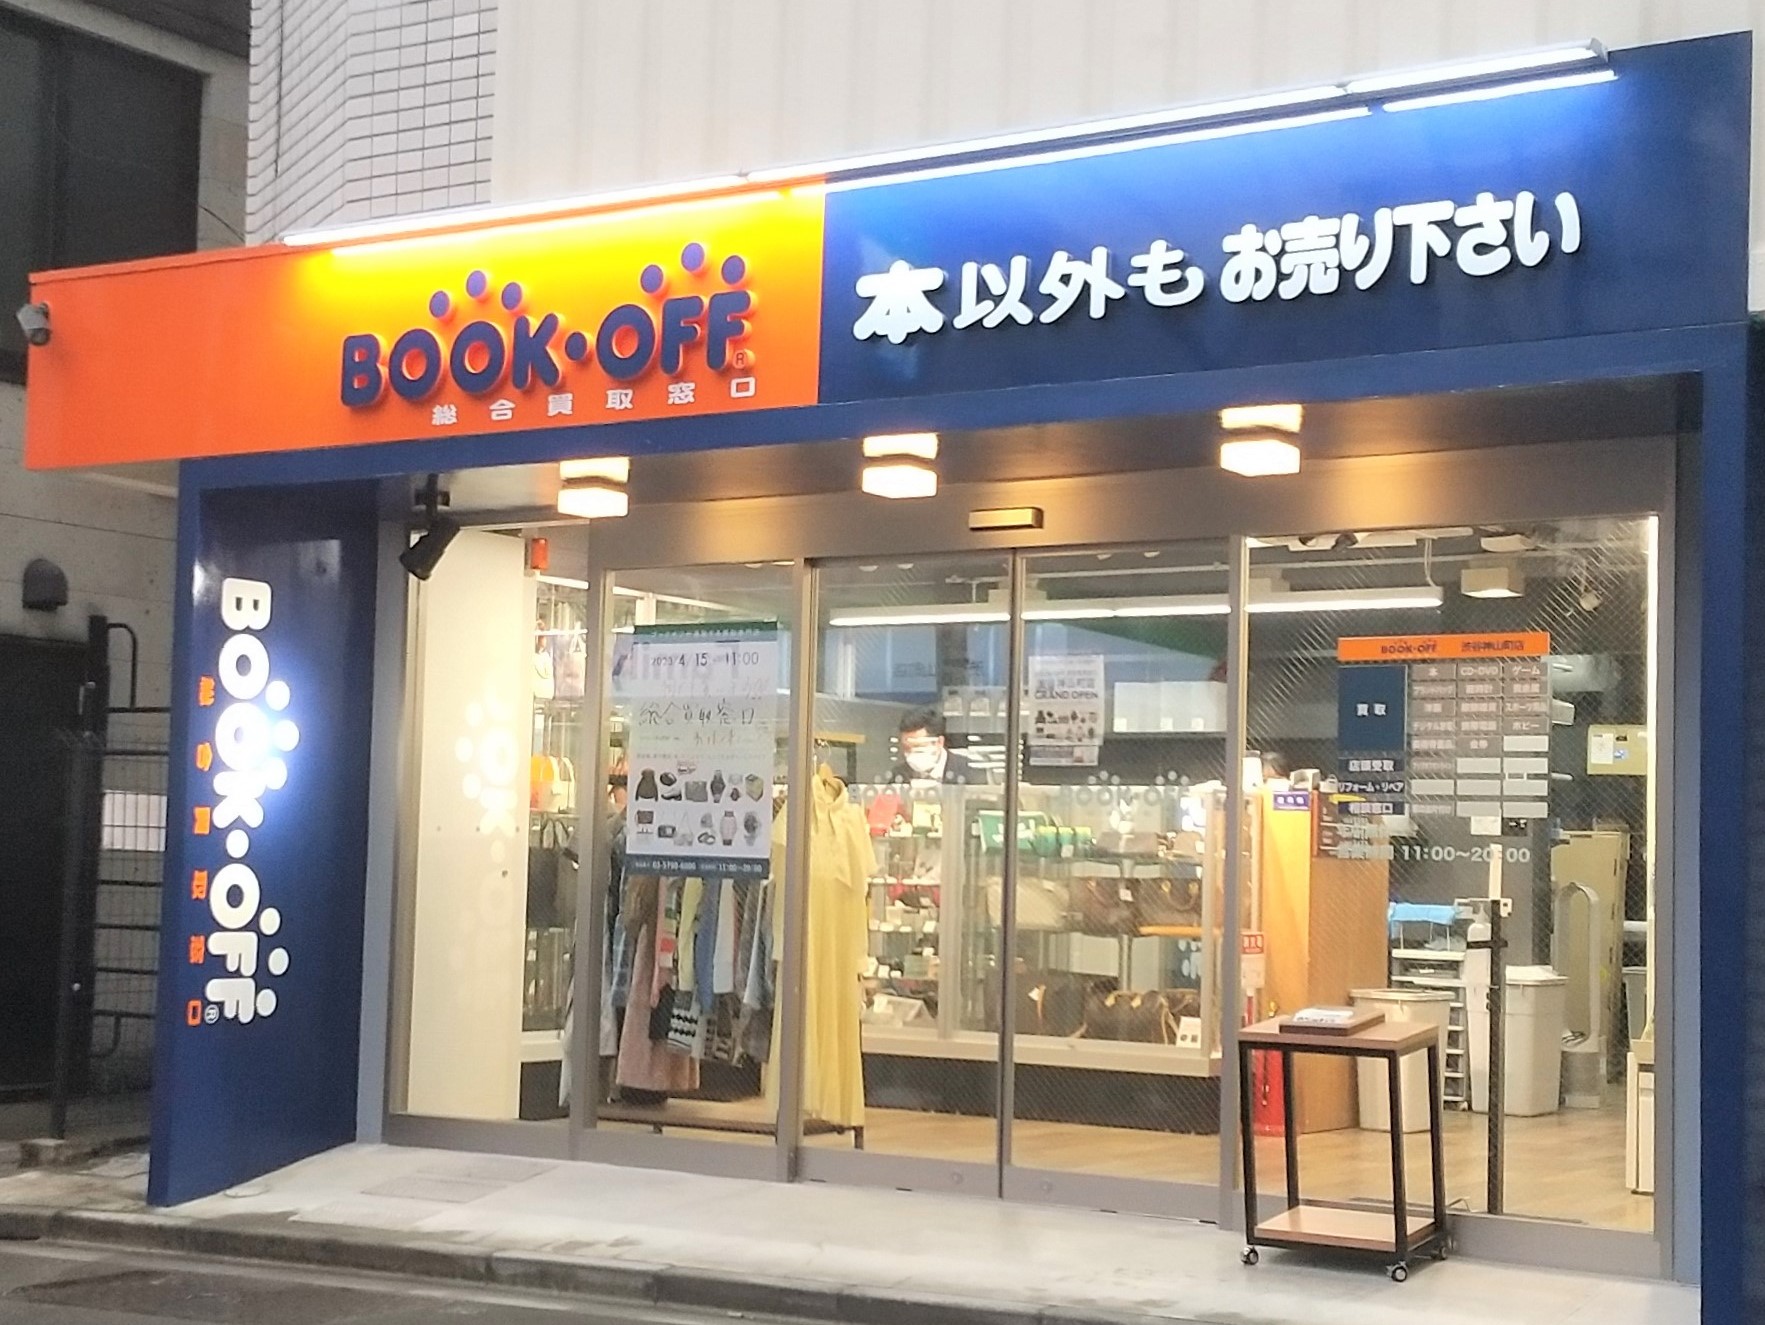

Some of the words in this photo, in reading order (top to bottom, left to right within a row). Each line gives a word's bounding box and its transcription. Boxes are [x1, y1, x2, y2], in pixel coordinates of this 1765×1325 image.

[431, 375, 757, 426] 総合買取窓口
